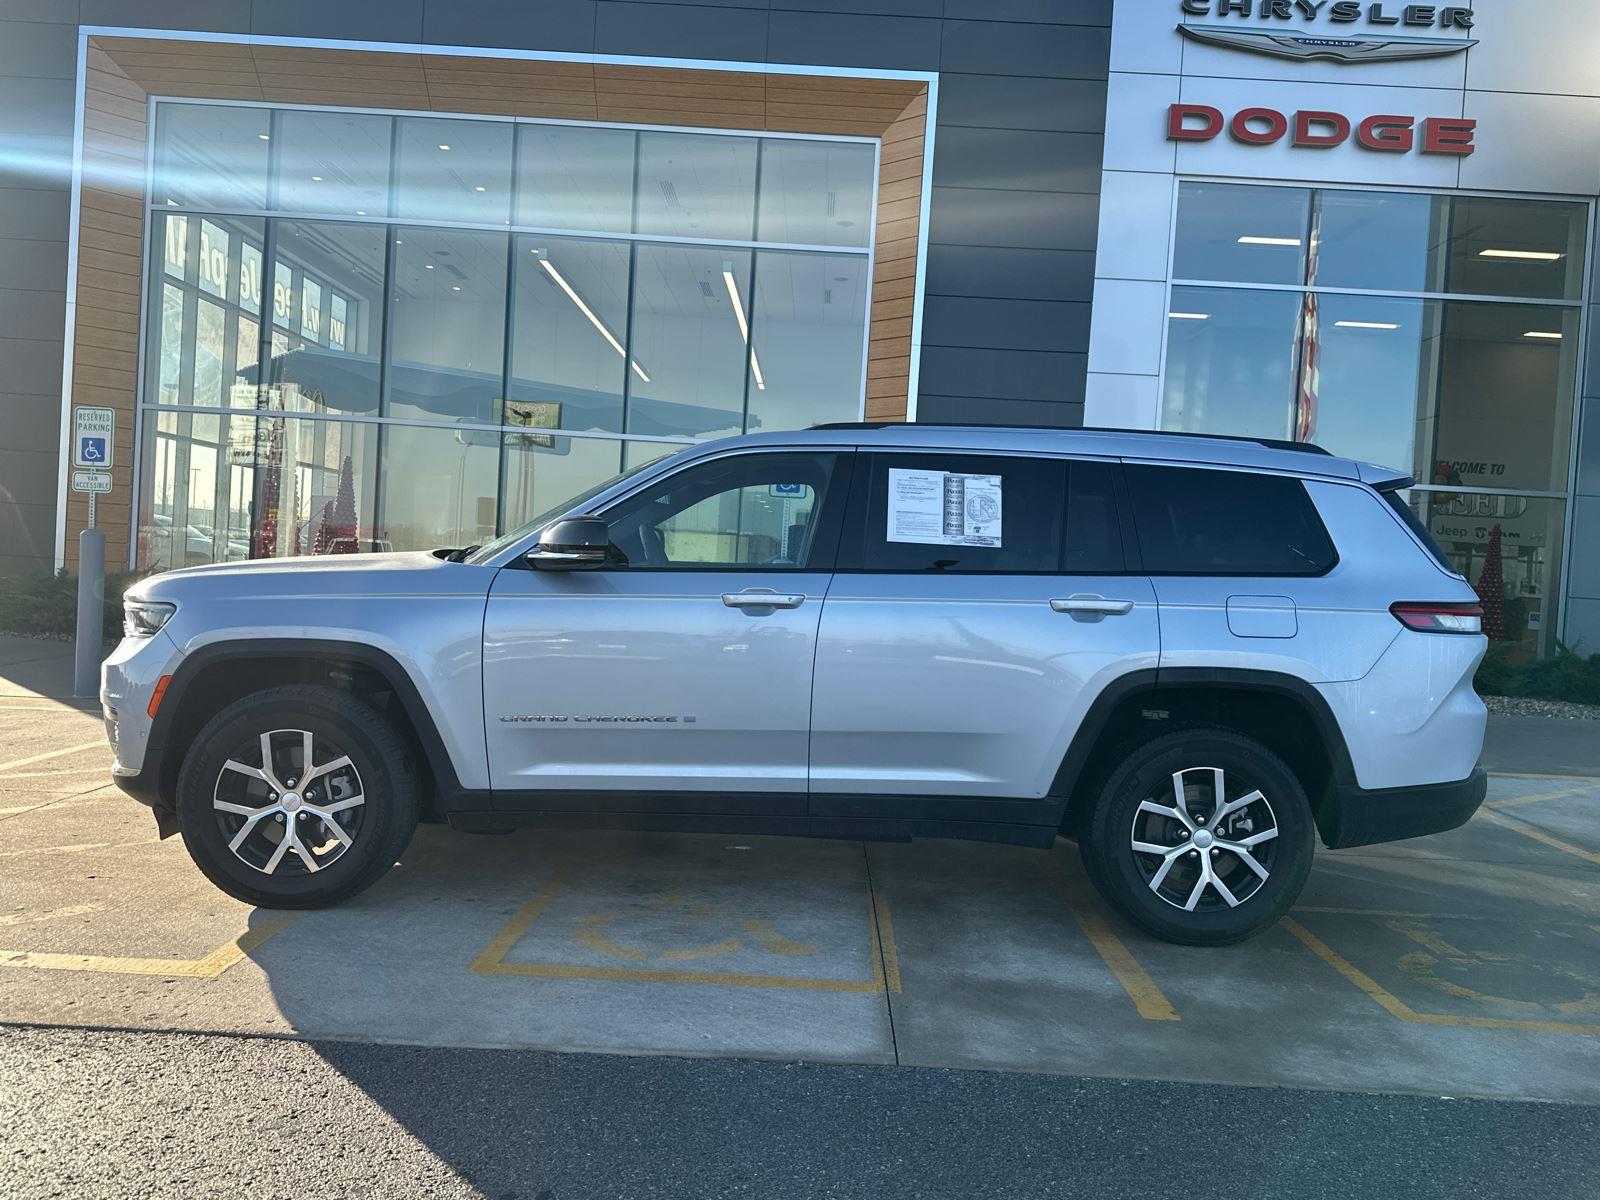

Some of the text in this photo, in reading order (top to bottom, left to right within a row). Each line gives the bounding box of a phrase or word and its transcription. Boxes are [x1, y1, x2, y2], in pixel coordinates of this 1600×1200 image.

[1181, 0, 1476, 29] CHRYSLER
[1298, 38, 1357, 47] CHRYSLER
[1166, 103, 1477, 157] DODGE
[78, 412, 111, 422] RESERVED
[78, 423, 110, 433] PARKING
[1436, 460, 1506, 476] COME TO
[75, 481, 109, 490] ACCESSIBLE
[1436, 525, 1468, 538] Jeep
[499, 714, 569, 723] GRAND
[573, 714, 679, 723] CHEROKEE
